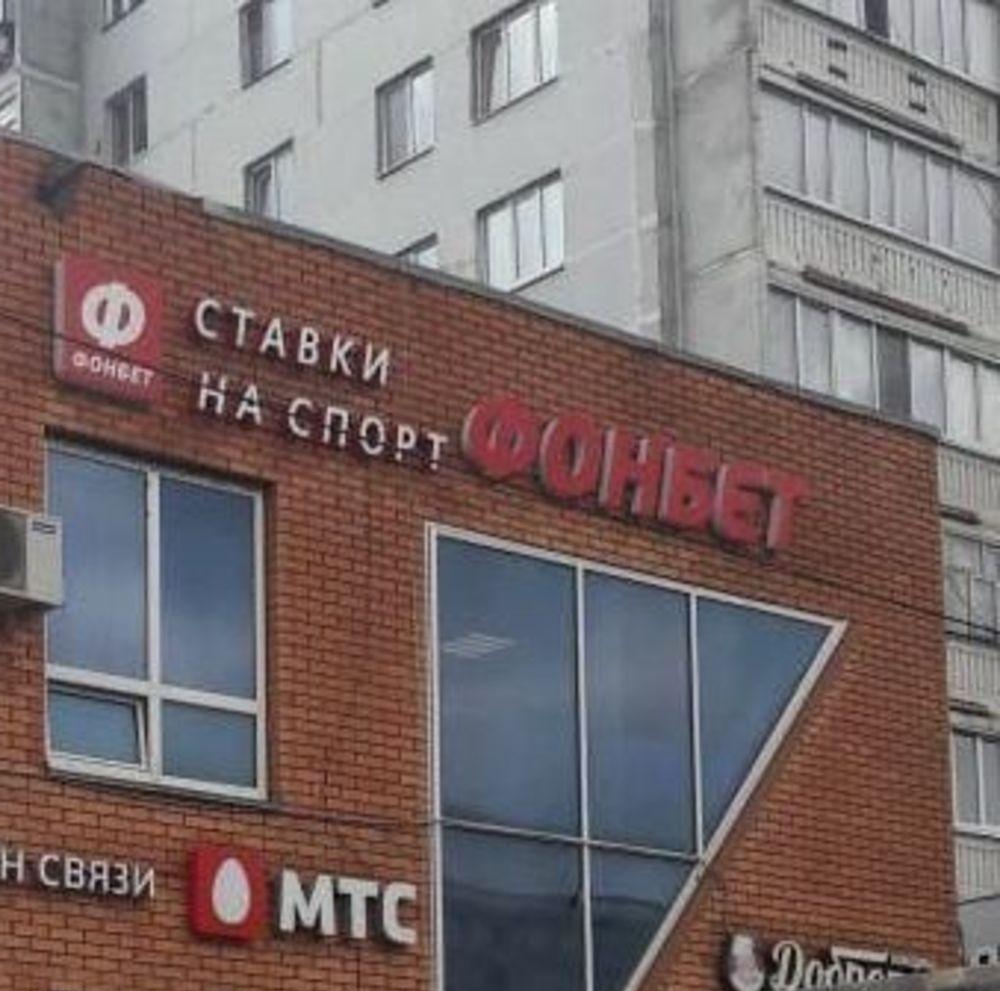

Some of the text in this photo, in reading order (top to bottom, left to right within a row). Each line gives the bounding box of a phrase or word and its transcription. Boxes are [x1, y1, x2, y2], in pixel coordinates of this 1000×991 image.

[72, 352, 155, 387] ФОНБЕТ
[194, 298, 391, 387] СТАВКИ
[198, 371, 449, 470] НА СПОРТ
[463, 394, 809, 550] ФОНБЕТ
[39, 853, 155, 898] связи
[279, 868, 418, 945] МТС
